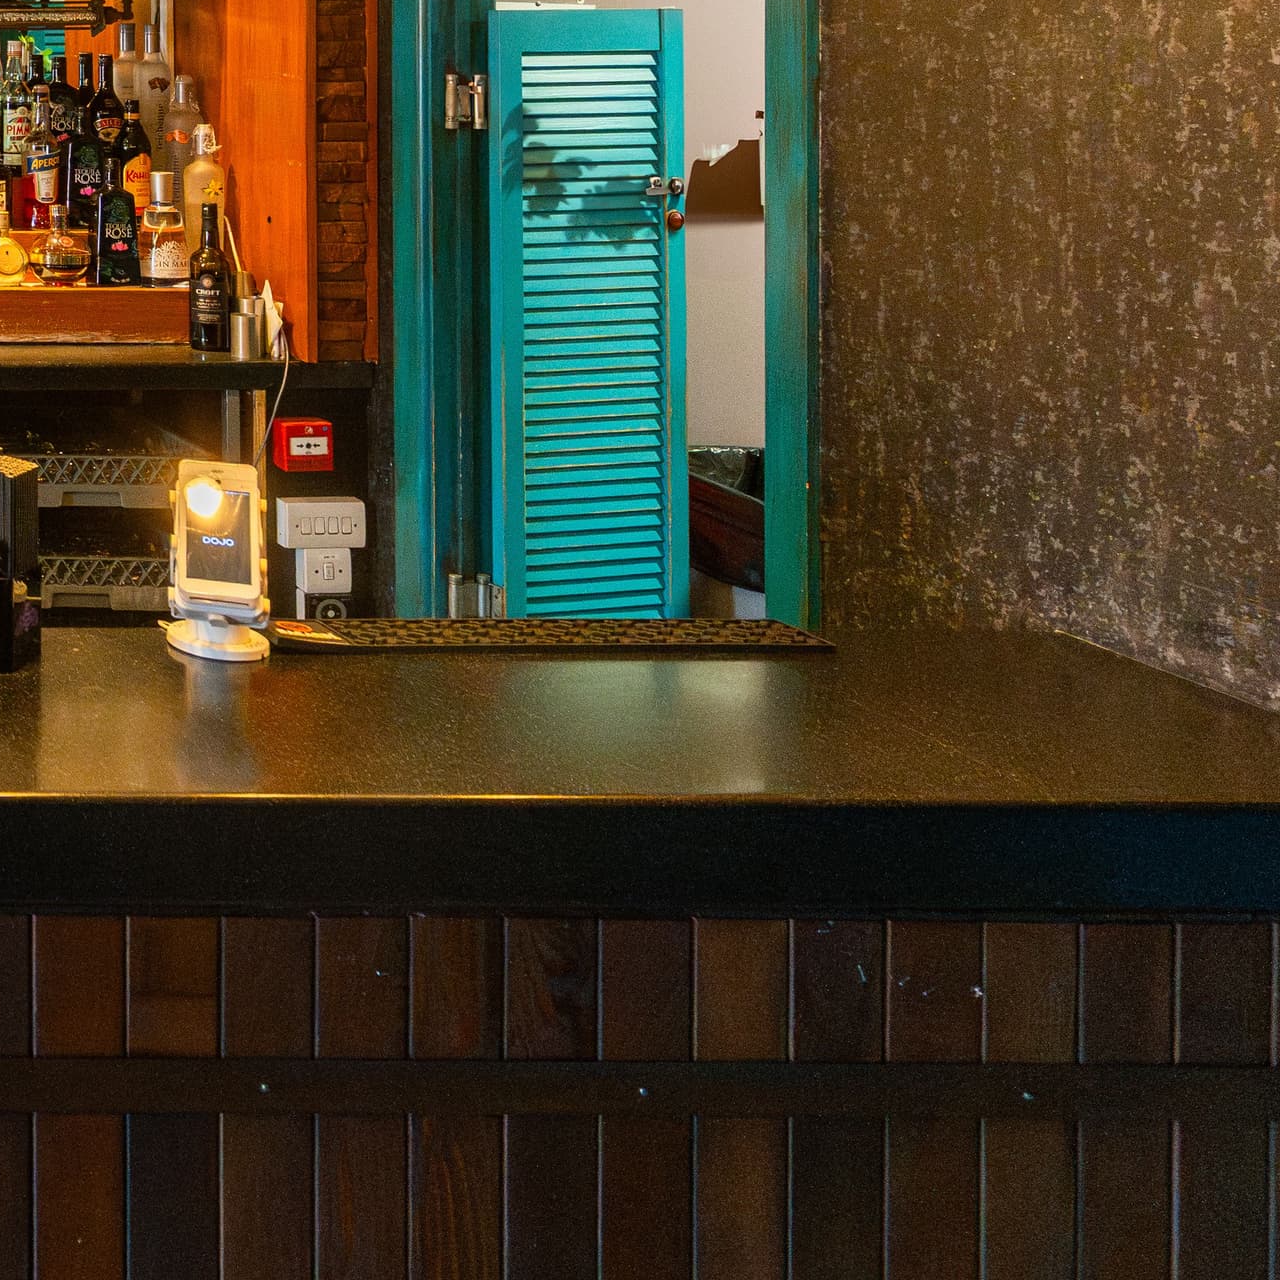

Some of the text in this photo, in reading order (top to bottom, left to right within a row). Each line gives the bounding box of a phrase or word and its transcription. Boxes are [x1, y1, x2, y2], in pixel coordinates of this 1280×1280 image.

[6, 125, 31, 136] PIMM
[31, 156, 60, 170] APERO
[74, 174, 102, 185] ROSE
[105, 228, 133, 239] ROSE
[202, 536, 234, 547] DOJO
